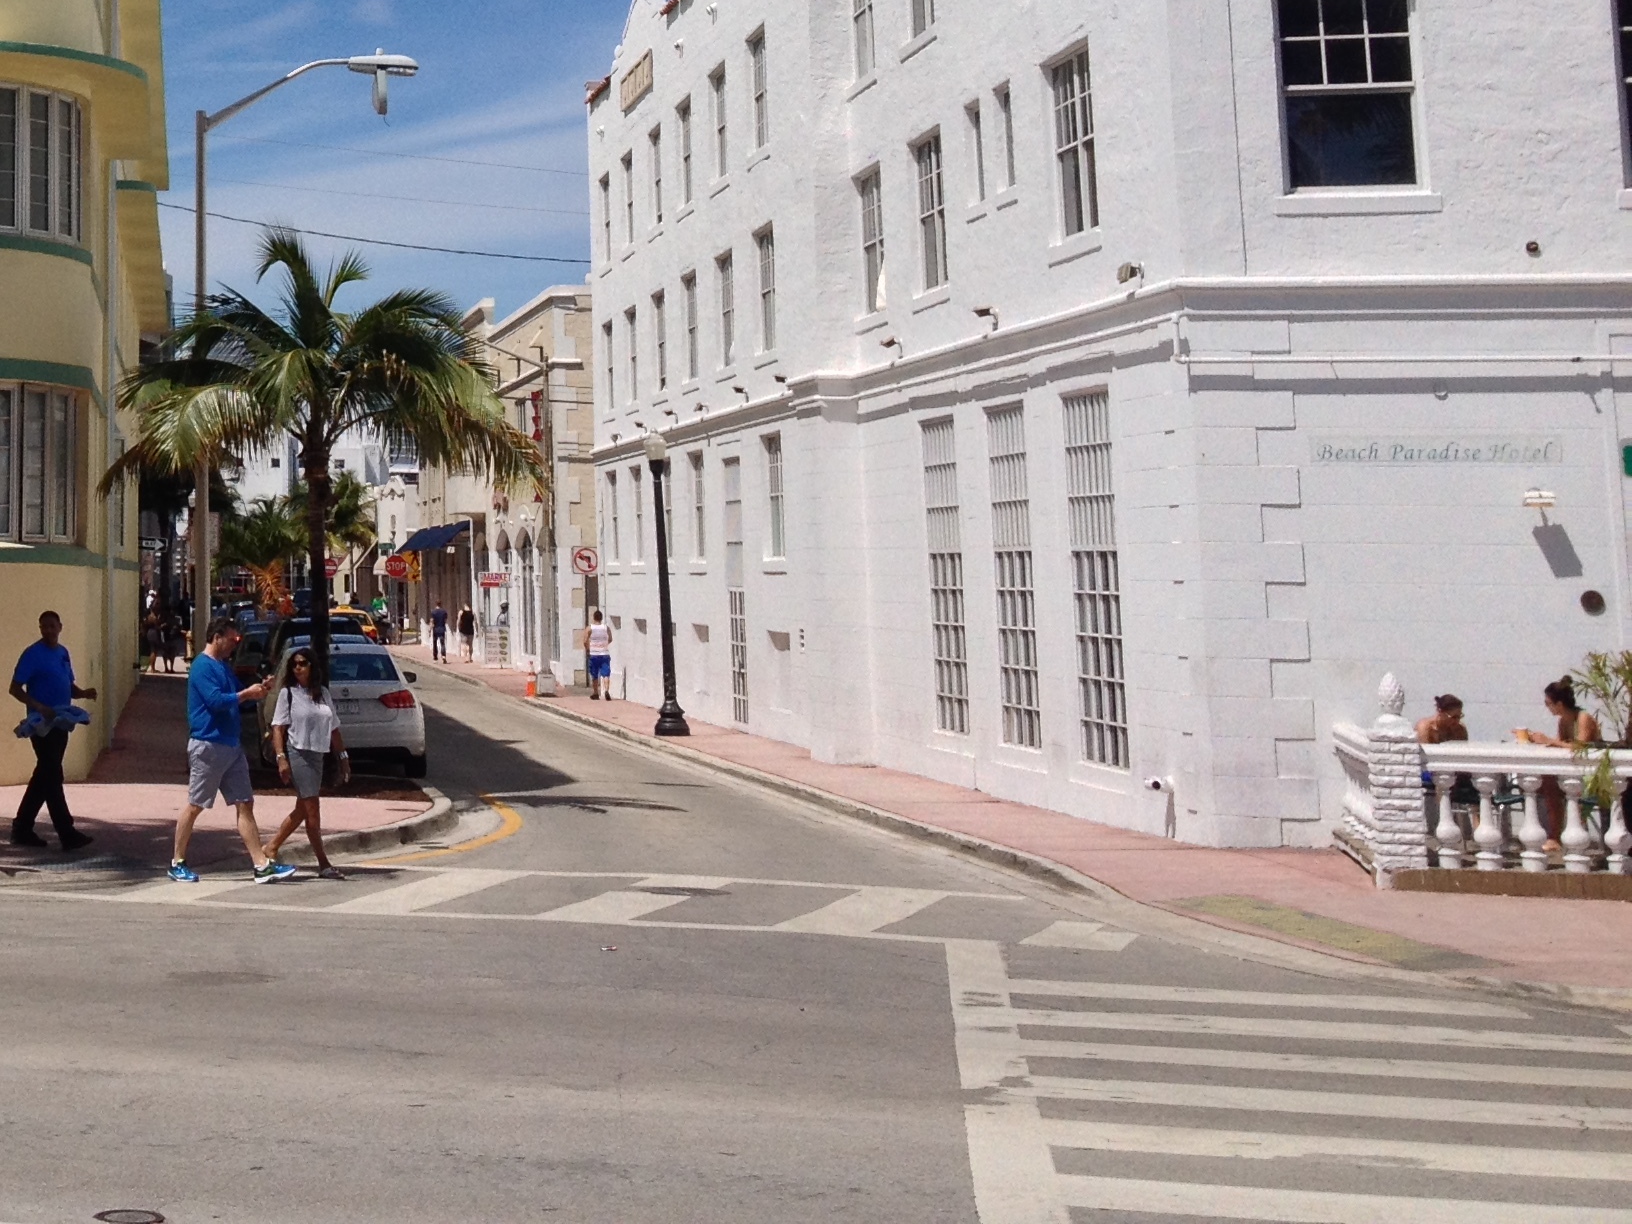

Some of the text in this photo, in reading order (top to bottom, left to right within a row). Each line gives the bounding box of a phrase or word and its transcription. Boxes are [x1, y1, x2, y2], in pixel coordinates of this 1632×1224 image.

[1316, 441, 1553, 460] Beach Paradise Hotel
[386, 561, 406, 571] STOP
[483, 572, 511, 582] MARKET
